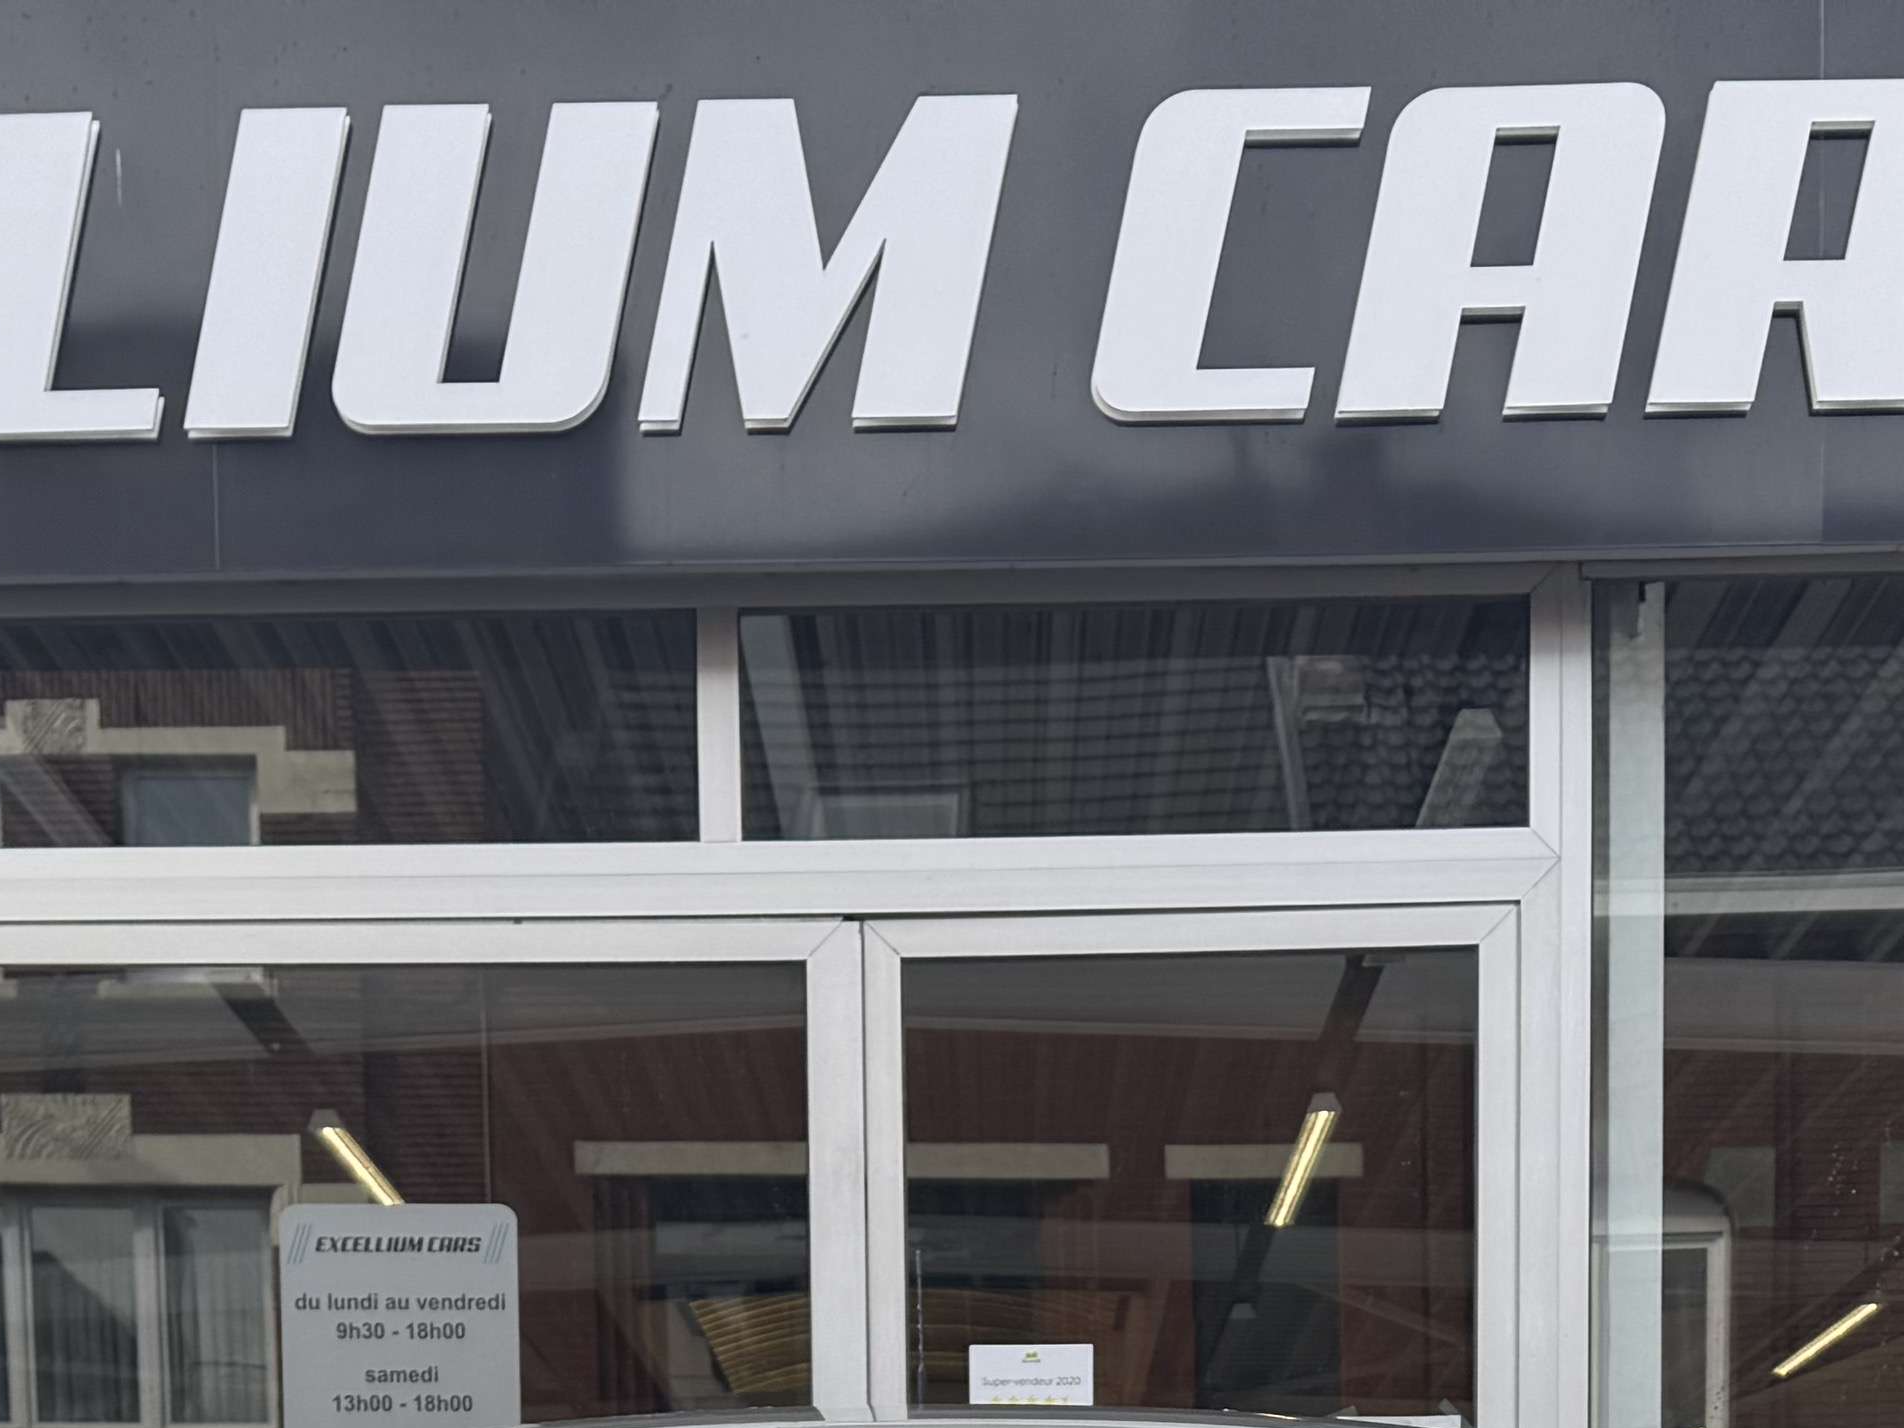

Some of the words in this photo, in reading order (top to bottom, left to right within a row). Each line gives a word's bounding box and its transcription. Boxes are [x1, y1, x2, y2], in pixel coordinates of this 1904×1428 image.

[315, 1236, 424, 1253] EXCELLIUM
[427, 1236, 482, 1253] CARS
[294, 1293, 321, 1312] du
[327, 1293, 379, 1311] lundi
[385, 1296, 410, 1311] au
[416, 1293, 507, 1311] vendredi
[335, 1322, 386, 1340] 9h30
[406, 1322, 467, 1340] 18h00
[364, 1366, 439, 1384] samedi
[332, 1395, 393, 1413] 13h00
[413, 1395, 474, 1413] 18h00
